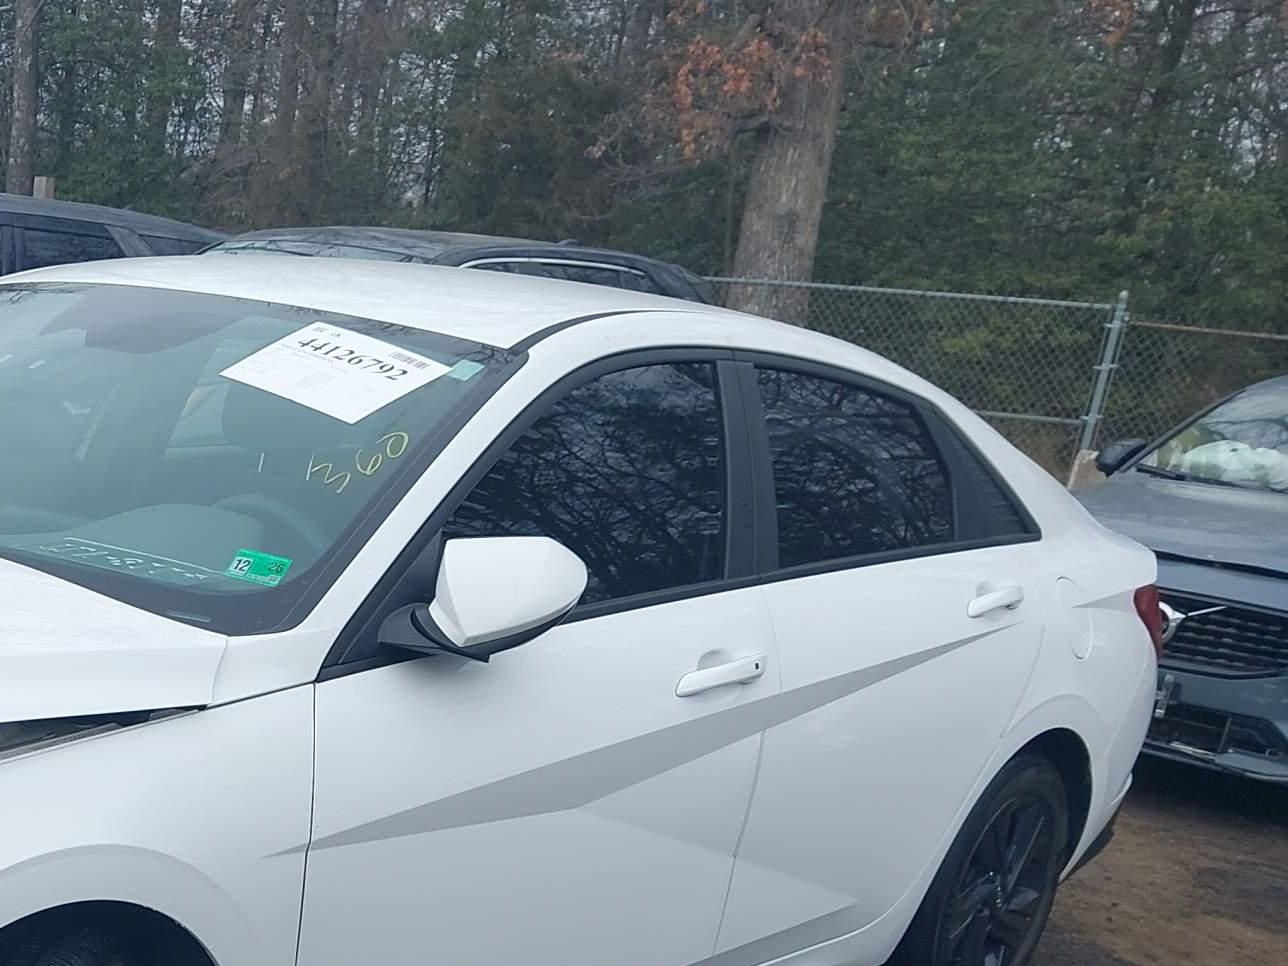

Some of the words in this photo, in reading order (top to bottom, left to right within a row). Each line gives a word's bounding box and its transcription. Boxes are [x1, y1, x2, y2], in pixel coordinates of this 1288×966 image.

[298, 338, 409, 381] 44126792
[233, 558, 252, 572] 12
[267, 562, 286, 574] 26
